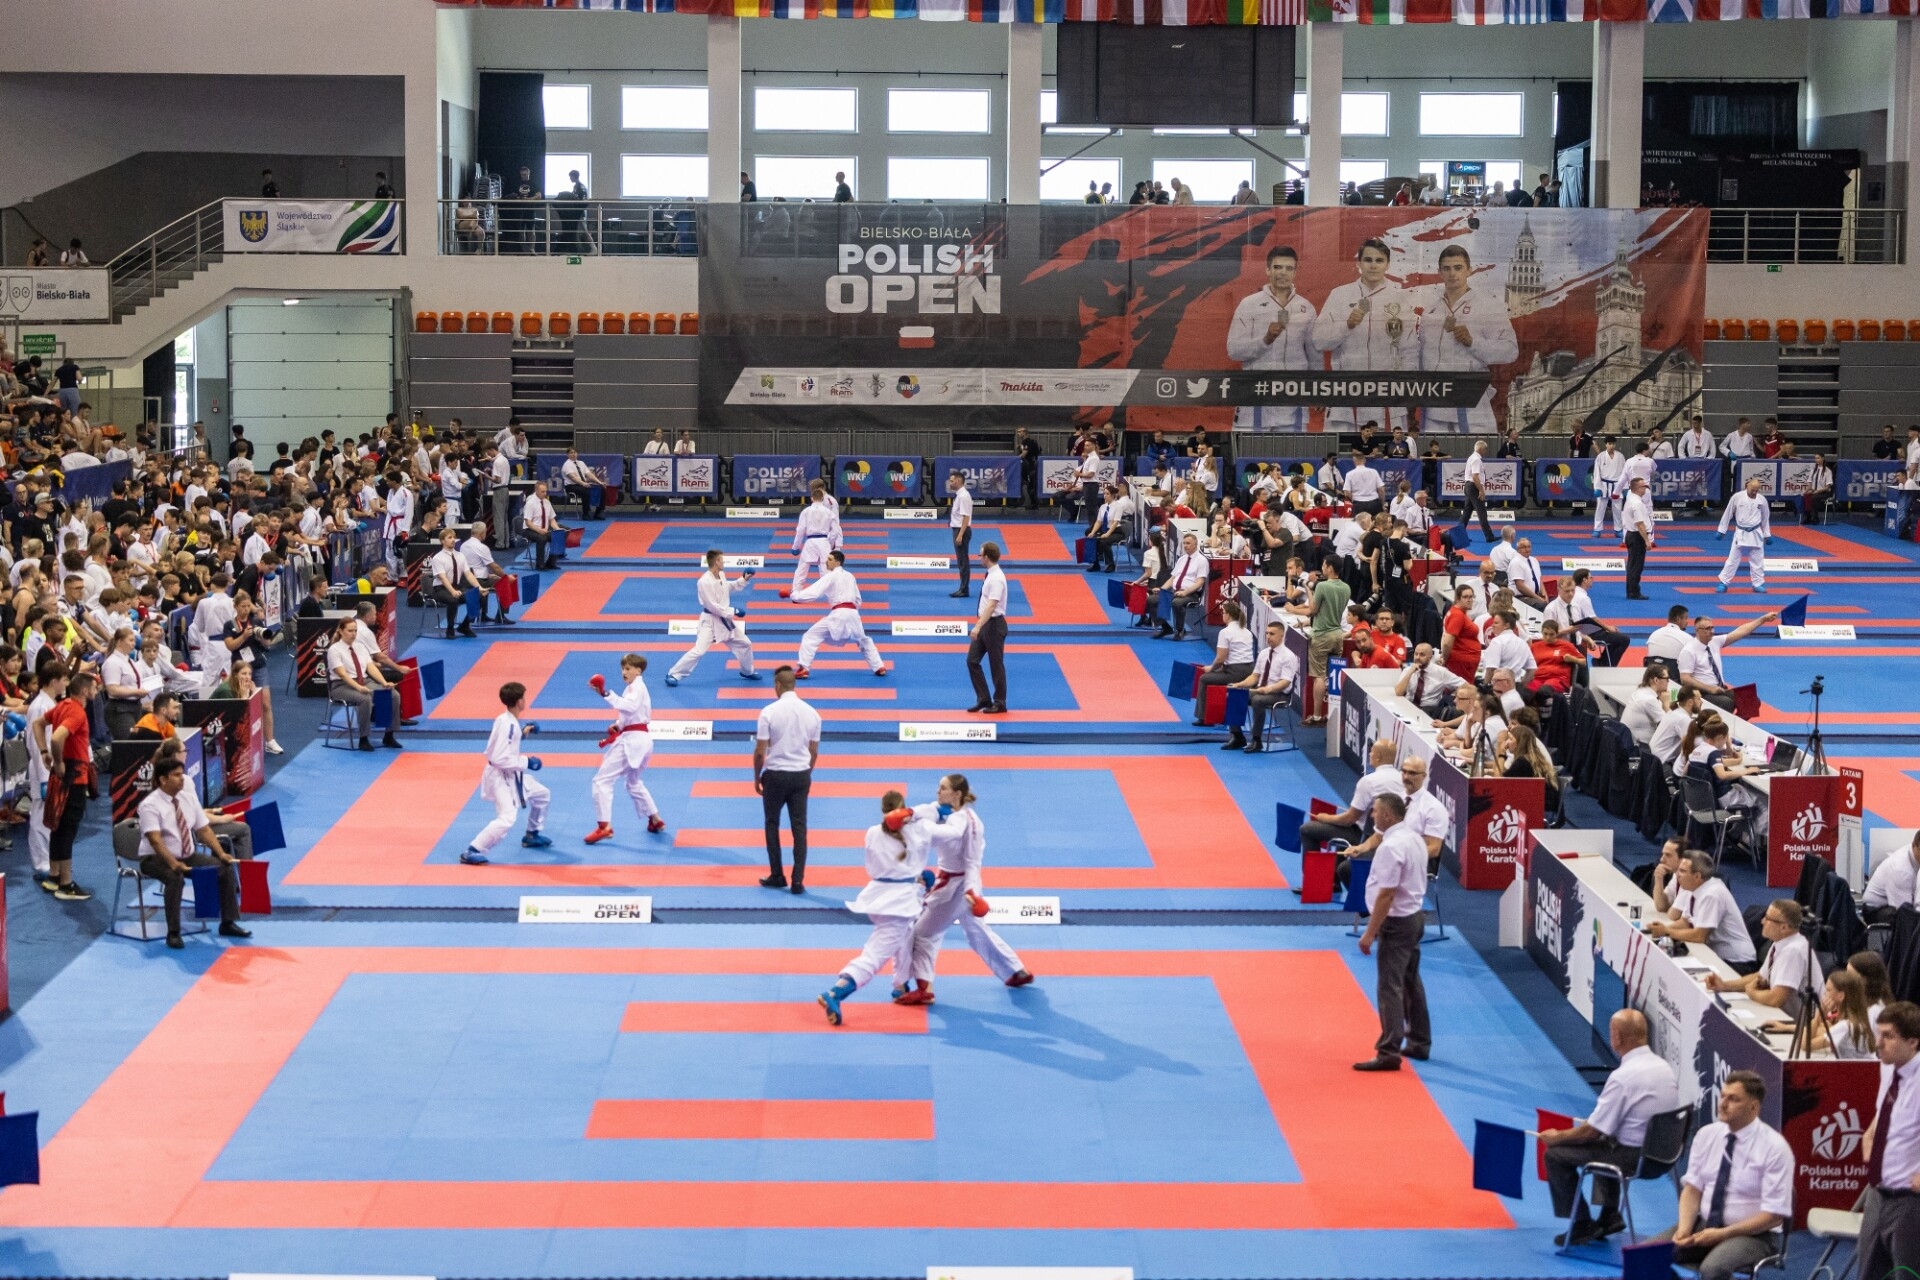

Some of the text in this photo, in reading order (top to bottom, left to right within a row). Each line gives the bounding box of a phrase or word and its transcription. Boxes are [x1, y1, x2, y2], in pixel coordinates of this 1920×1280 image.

[277, 211, 332, 220] Województwo
[276, 223, 305, 232] Śląskie
[860, 226, 973, 239] BIELSKO-BIAŁA
[838, 243, 994, 274] POLISH
[36, 290, 91, 301] Bielsko-Biała
[825, 275, 1001, 314] OPEN
[1254, 380, 1453, 397] #POLISHOPENWKF
[748, 467, 805, 479] POLISH
[847, 472, 868, 482] WKF
[890, 473, 911, 483] WKF
[1852, 472, 1896, 483] POLIS
[640, 477, 669, 487] Atemi
[680, 478, 710, 488] Atemi
[1046, 480, 1072, 490] Atem
[1547, 475, 1567, 484] WKF
[744, 478, 807, 493] OPEN
[1446, 481, 1465, 491] Ate
[1785, 481, 1809, 492] Atem
[1847, 483, 1889, 498] OP
[1841, 769, 1862, 779] TATAMI
[1845, 782, 1857, 809] 3
[1480, 846, 1507, 854] Polska
[1784, 844, 1831, 852] Polska Unia
[1537, 877, 1562, 925] POLISH
[594, 910, 641, 919] OPEN
[1535, 904, 1562, 962] OPEN
[1800, 1164, 1842, 1176] Polska
[1809, 1177, 1860, 1190] Karate
